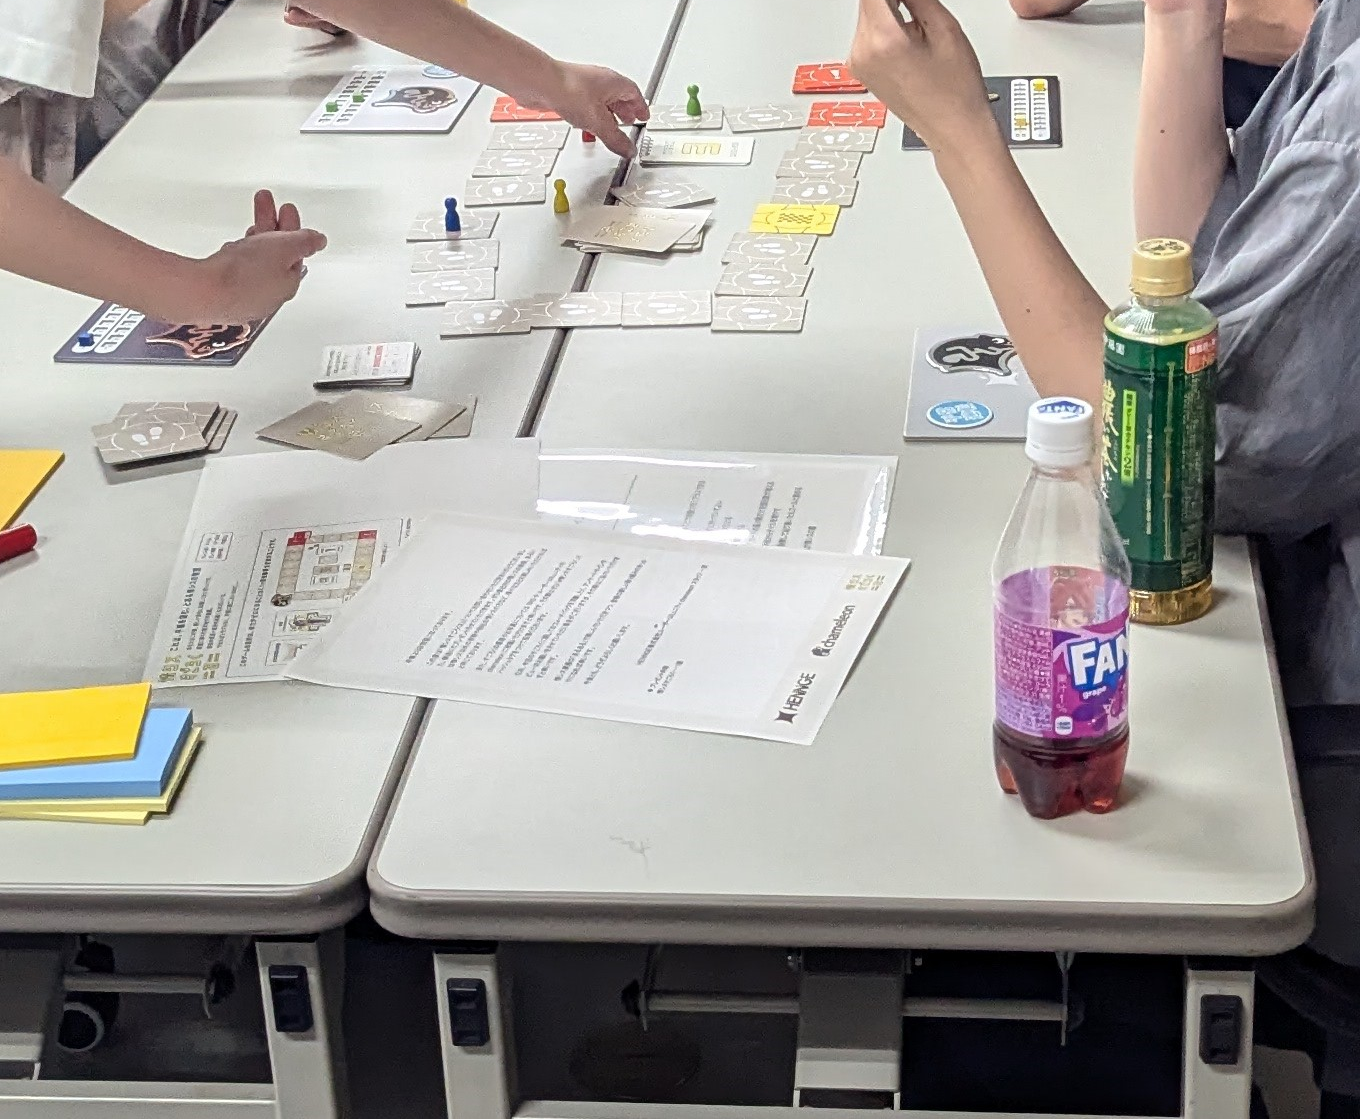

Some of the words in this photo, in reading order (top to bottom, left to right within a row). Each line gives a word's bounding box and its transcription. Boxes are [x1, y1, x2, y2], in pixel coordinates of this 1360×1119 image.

[817, 603, 857, 648] chameleon
[780, 671, 818, 711] HENNGE
[1083, 685, 1107, 700] grape
